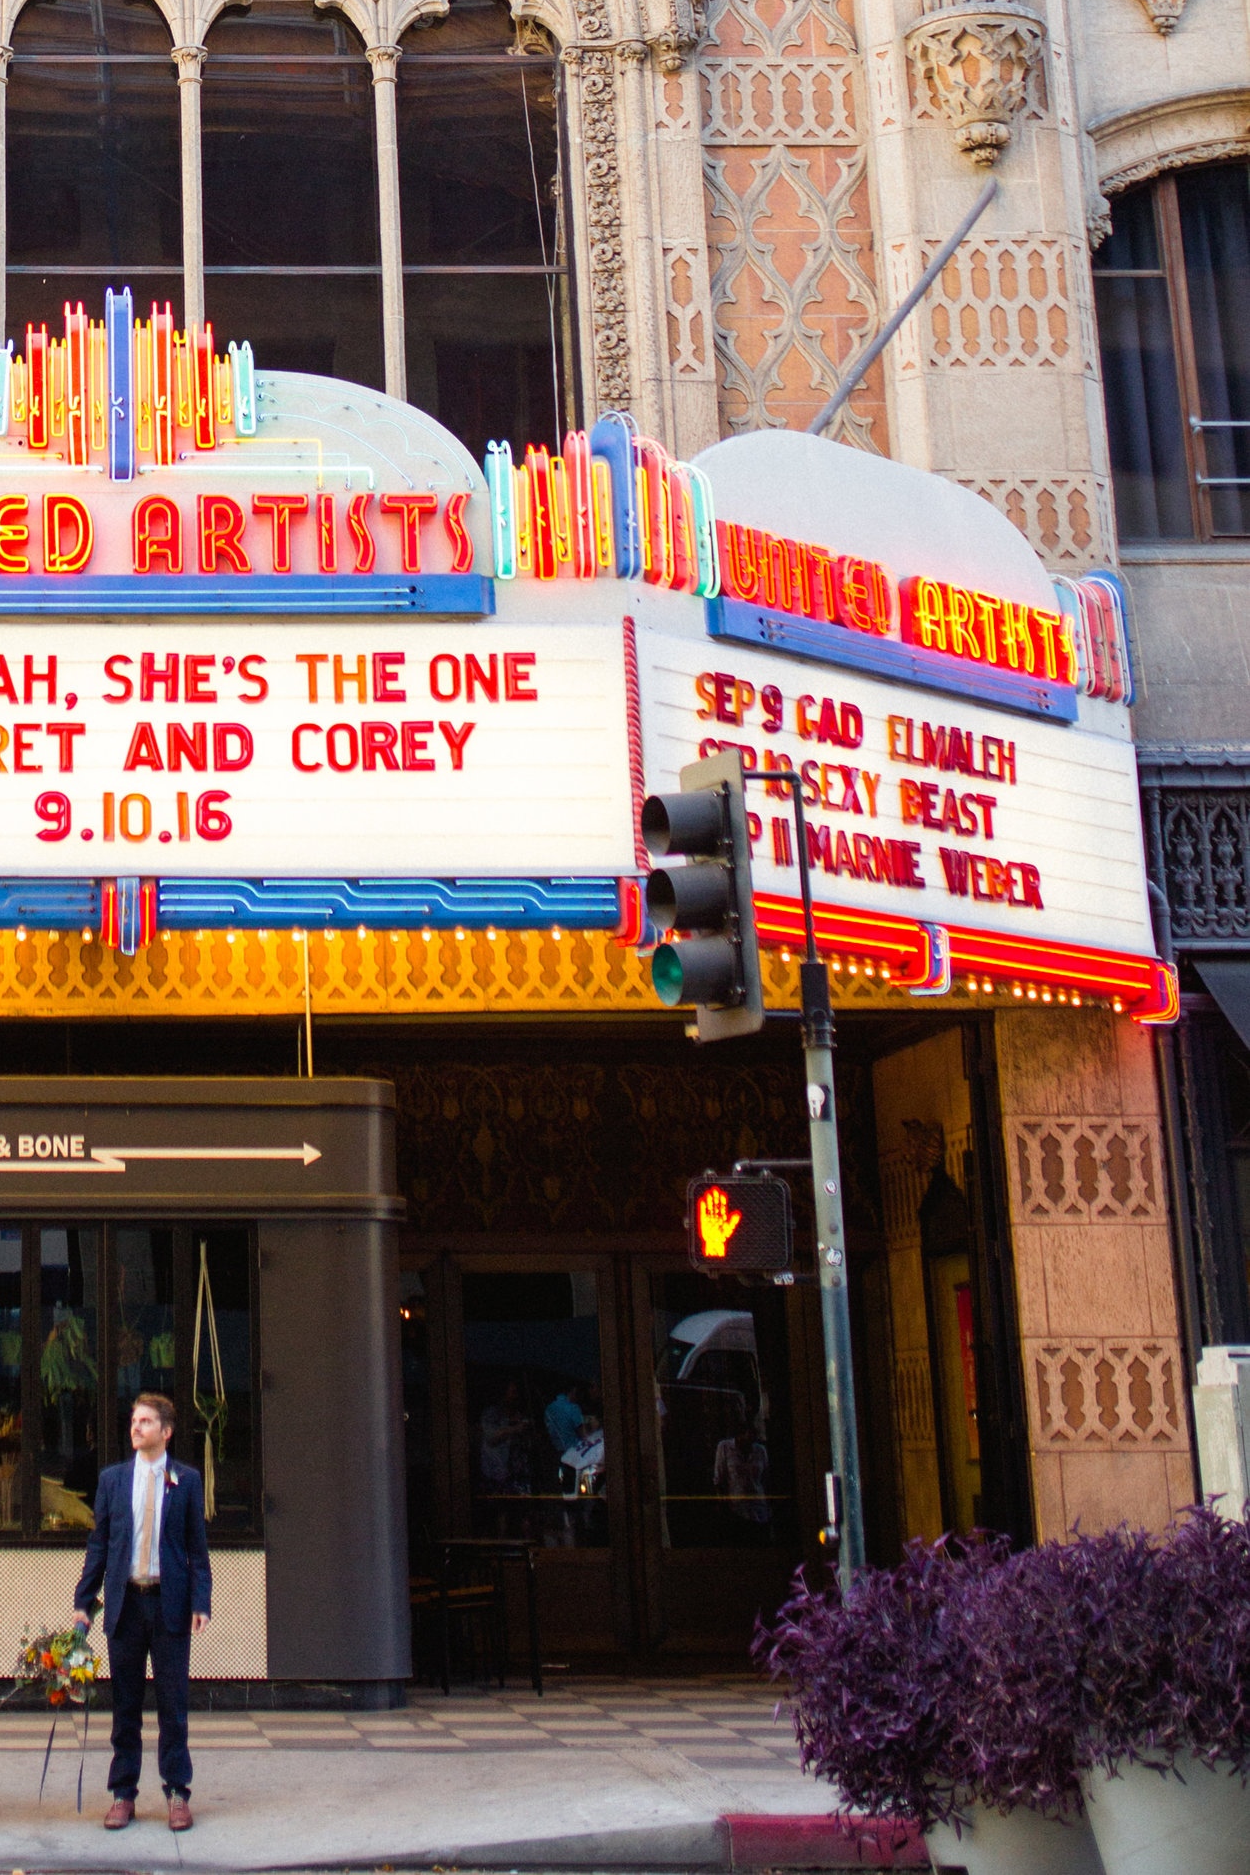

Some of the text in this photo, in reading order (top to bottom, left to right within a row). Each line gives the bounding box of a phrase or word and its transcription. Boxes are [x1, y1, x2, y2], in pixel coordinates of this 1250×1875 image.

[132, 492, 474, 574] ARTISTS
[718, 520, 1079, 686] UNITED ARTISTS
[102, 652, 269, 705] SHE'S
[295, 651, 407, 704] THE
[429, 651, 538, 704] ONE
[123, 721, 254, 772] AND
[291, 720, 477, 774] COREY
[695, 672, 1017, 785] SEP 9 GAD ELMALEH
[34, 789, 233, 844] 9.10.16
[800, 760, 881, 818] SEXY
[900, 778, 998, 840] BEAST
[805, 821, 926, 889] MARNIE
[938, 846, 1045, 910] WEBER
[18, 1134, 85, 1158] BONE
